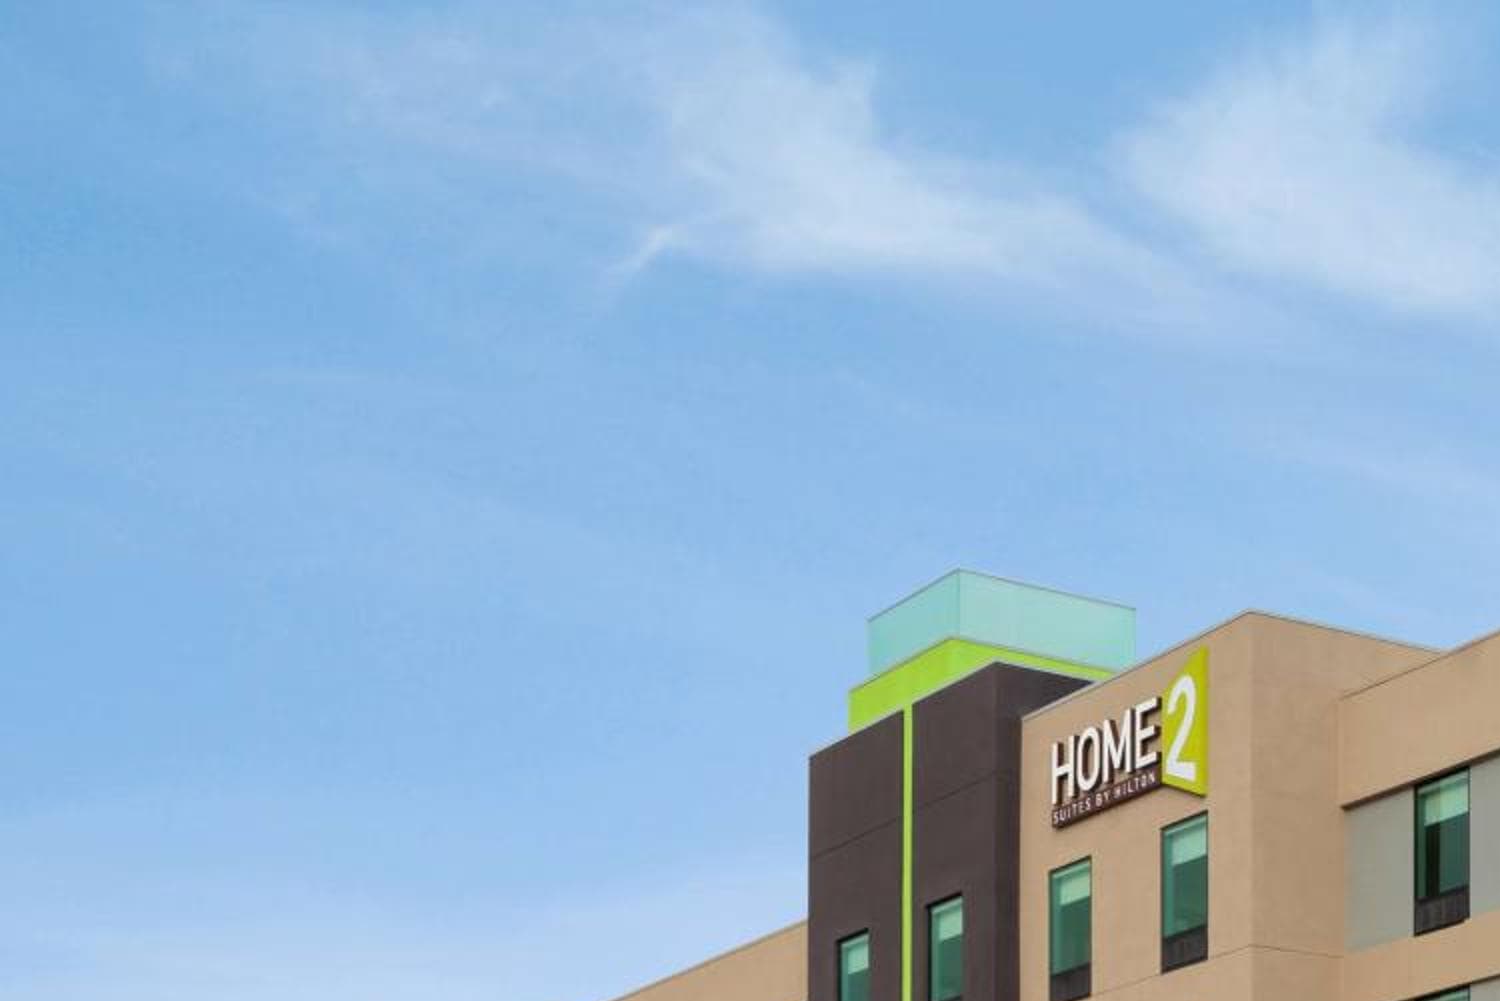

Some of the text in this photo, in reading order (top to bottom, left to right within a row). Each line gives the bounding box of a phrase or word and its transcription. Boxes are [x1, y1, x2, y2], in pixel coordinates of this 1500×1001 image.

[1051, 674, 1197, 804] HOME 2
[1052, 772, 1156, 824] SUITES BY HILTON
